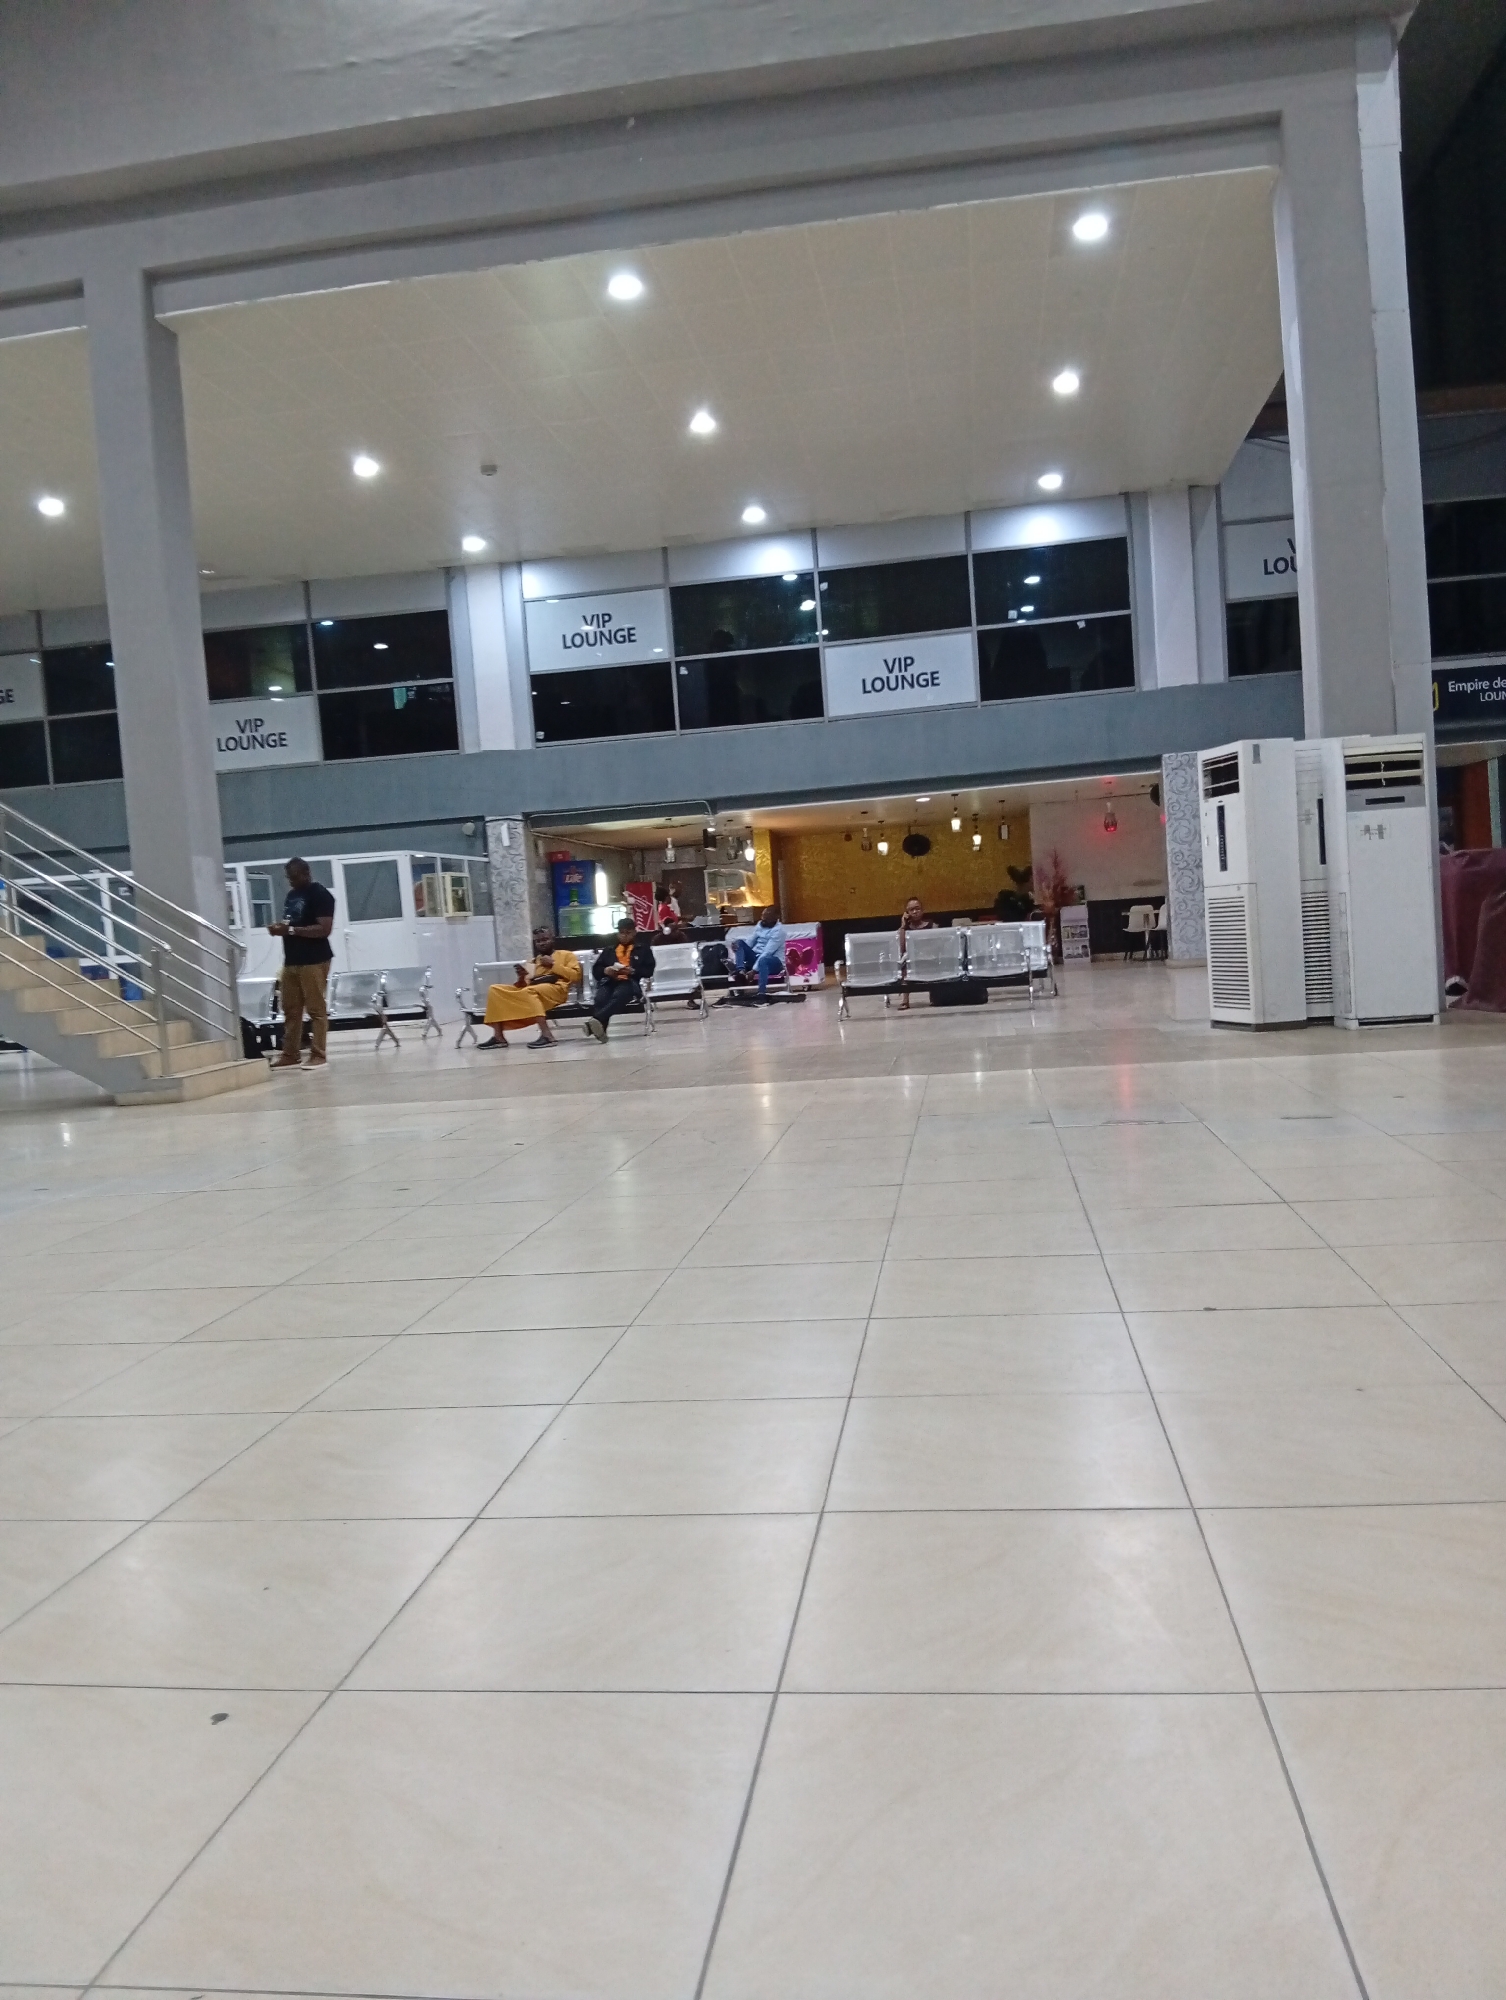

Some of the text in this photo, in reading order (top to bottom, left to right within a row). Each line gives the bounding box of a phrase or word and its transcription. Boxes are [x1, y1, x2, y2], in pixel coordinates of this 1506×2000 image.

[582, 612, 612, 629] VIP
[562, 627, 637, 649] LOUNGE
[883, 656, 915, 674] VIP
[862, 671, 941, 694] LOUNGE
[1448, 679, 1490, 694] Empire
[235, 718, 265, 734] VIP
[216, 731, 288, 752] LOUNGE
